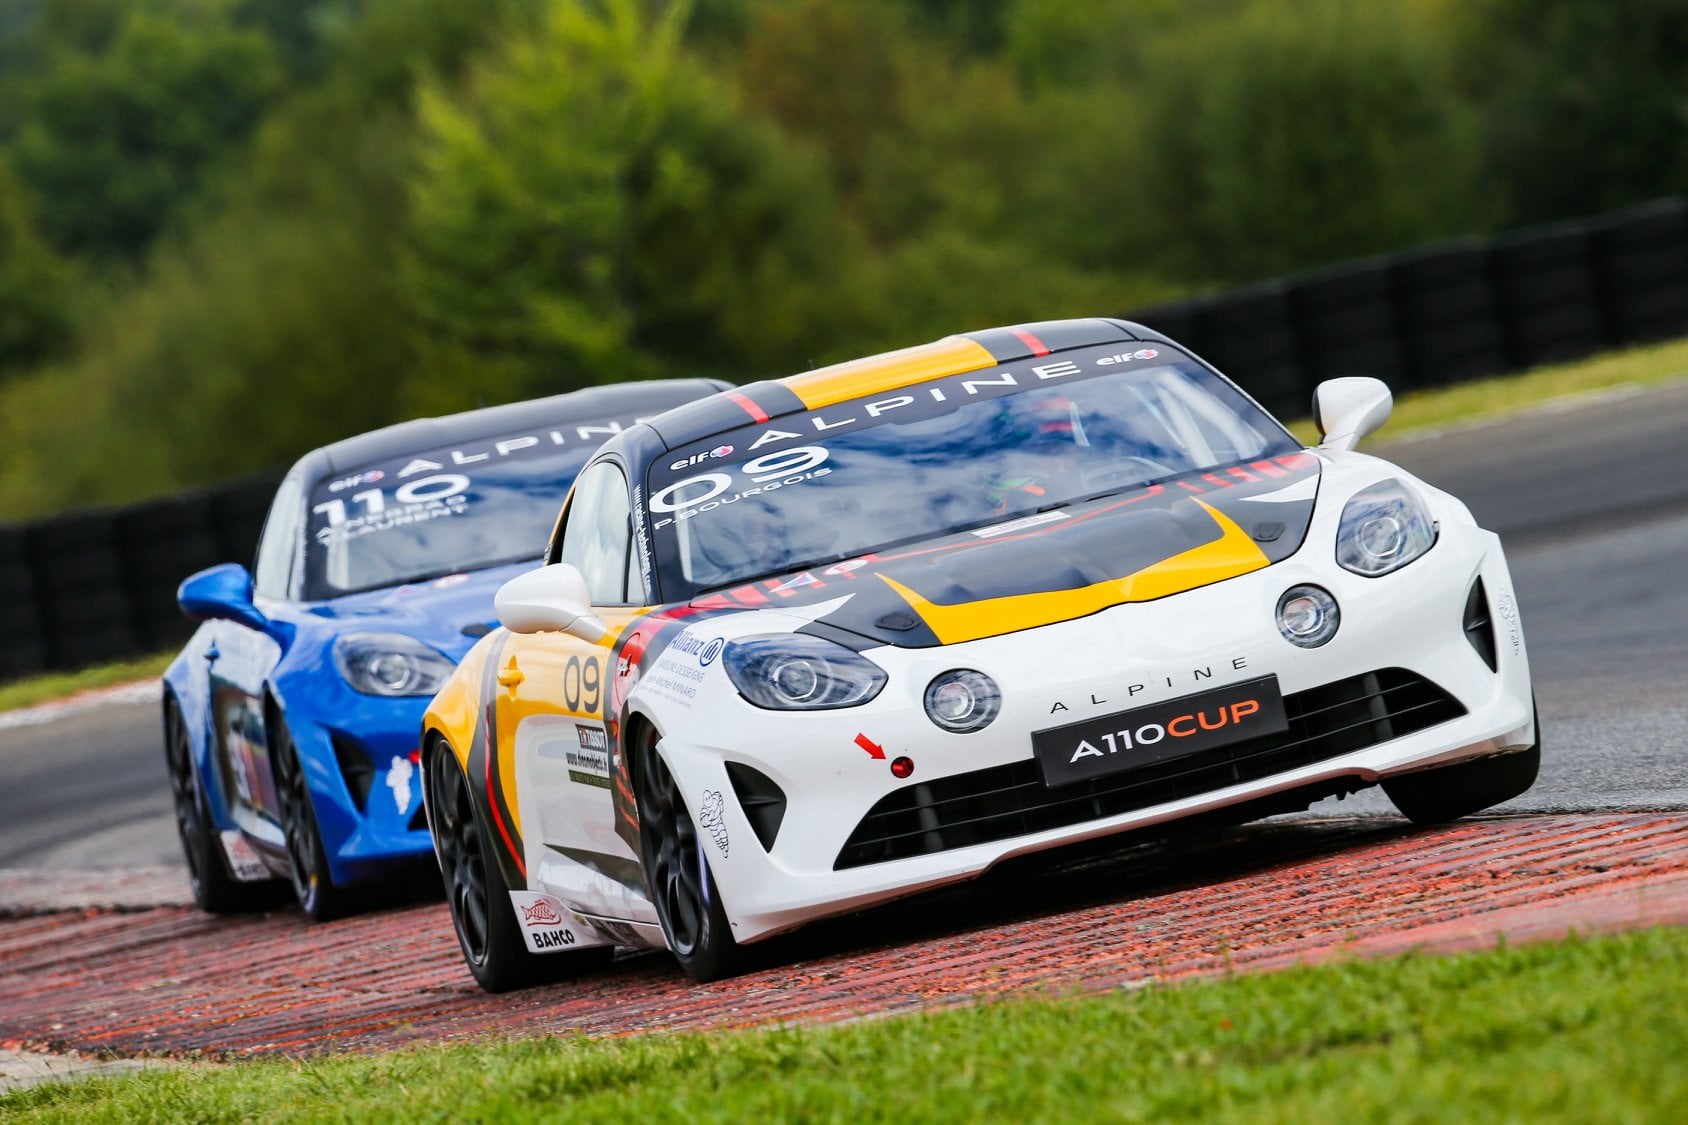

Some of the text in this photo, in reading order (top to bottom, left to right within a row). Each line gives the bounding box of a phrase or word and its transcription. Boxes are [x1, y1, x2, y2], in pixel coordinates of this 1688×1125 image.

[1096, 352, 1136, 366] elf
[747, 360, 1082, 451] ALPINE
[397, 416, 655, 478] ALPIN
[669, 450, 711, 471] elf
[312, 473, 471, 528] 110
[649, 446, 830, 514] 09
[654, 467, 833, 531] P.BOURGOIS
[667, 629, 706, 656] Allianz
[563, 655, 600, 714] 09
[1049, 656, 1249, 714] ALPINE
[1068, 699, 1260, 764] A110CUP
[532, 929, 576, 949] BAHCO
